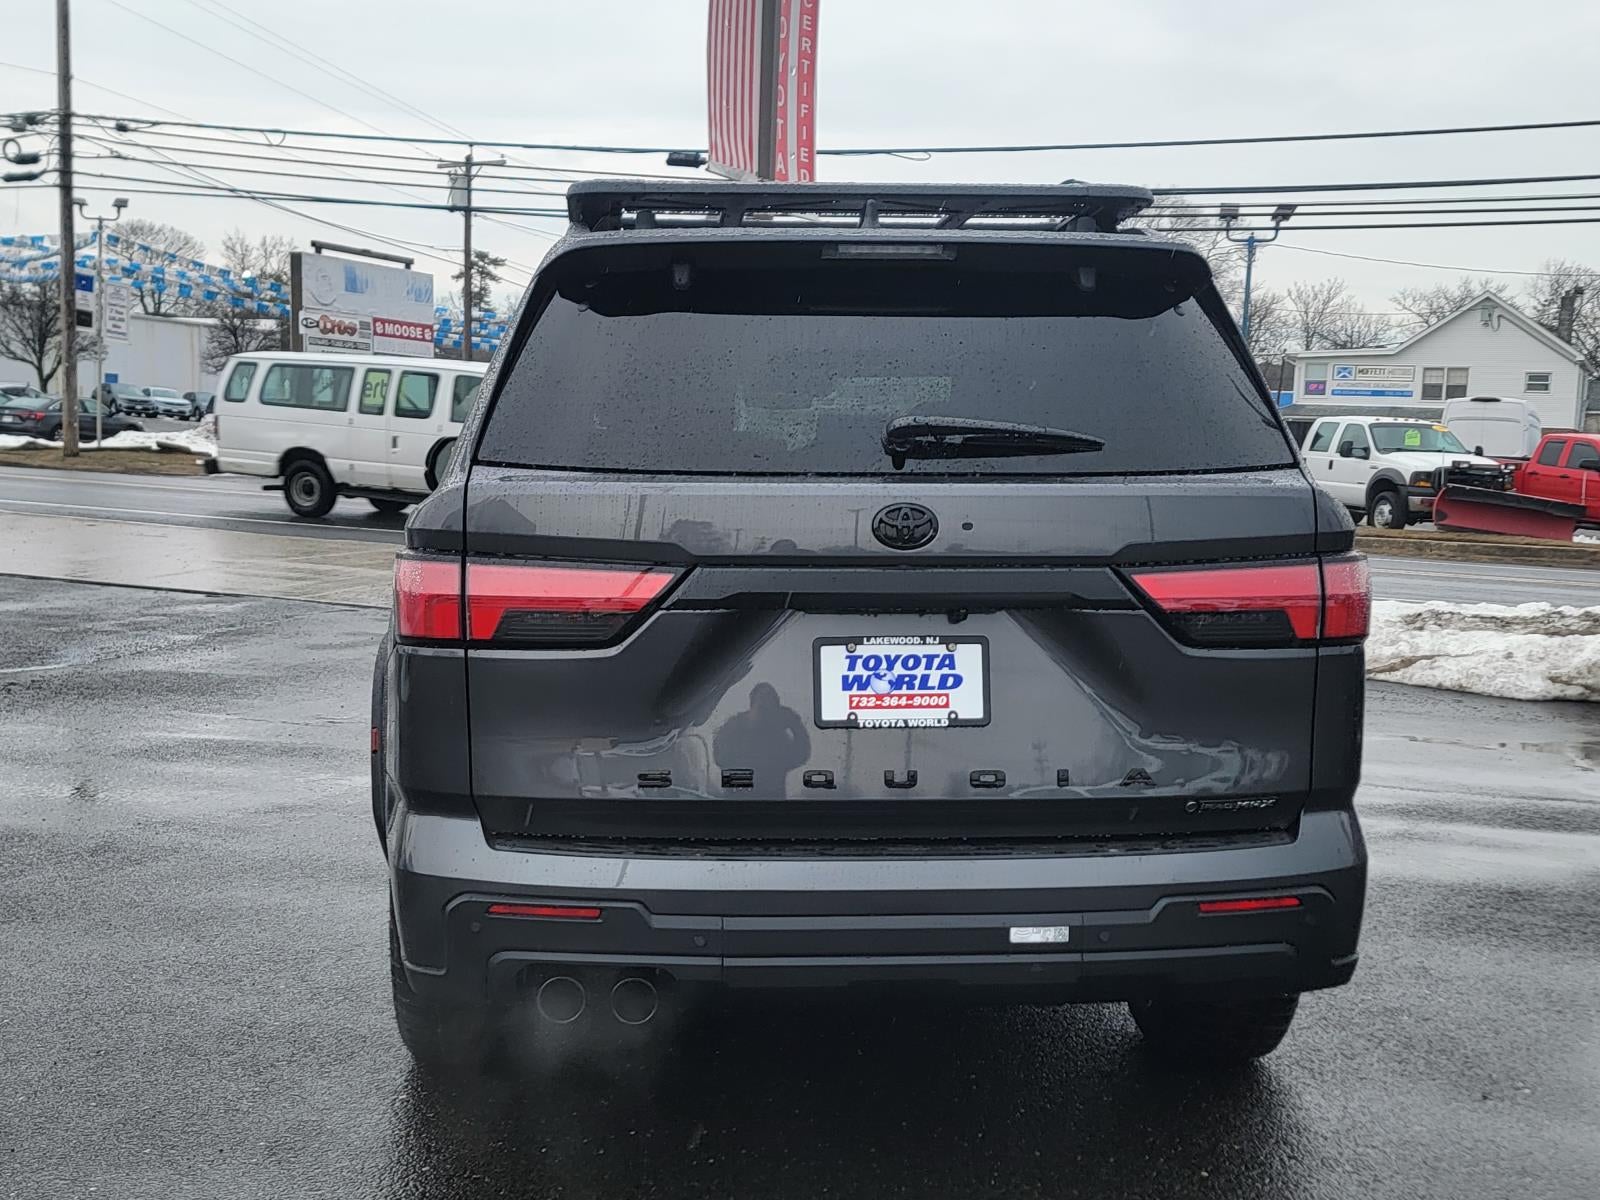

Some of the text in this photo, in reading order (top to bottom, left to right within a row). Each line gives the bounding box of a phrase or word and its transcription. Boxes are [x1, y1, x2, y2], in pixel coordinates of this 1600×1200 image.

[776, 0, 788, 175] OYOTA
[384, 322, 424, 339] MOOSE
[926, 636, 940, 645] NJ
[845, 653, 957, 672] TOYOTA
[841, 670, 964, 695] WORLD
[851, 695, 948, 707] 732-364-9000
[857, 718, 949, 728] TOYOTA WORLD
[637, 768, 1157, 789] SEQUOIA
